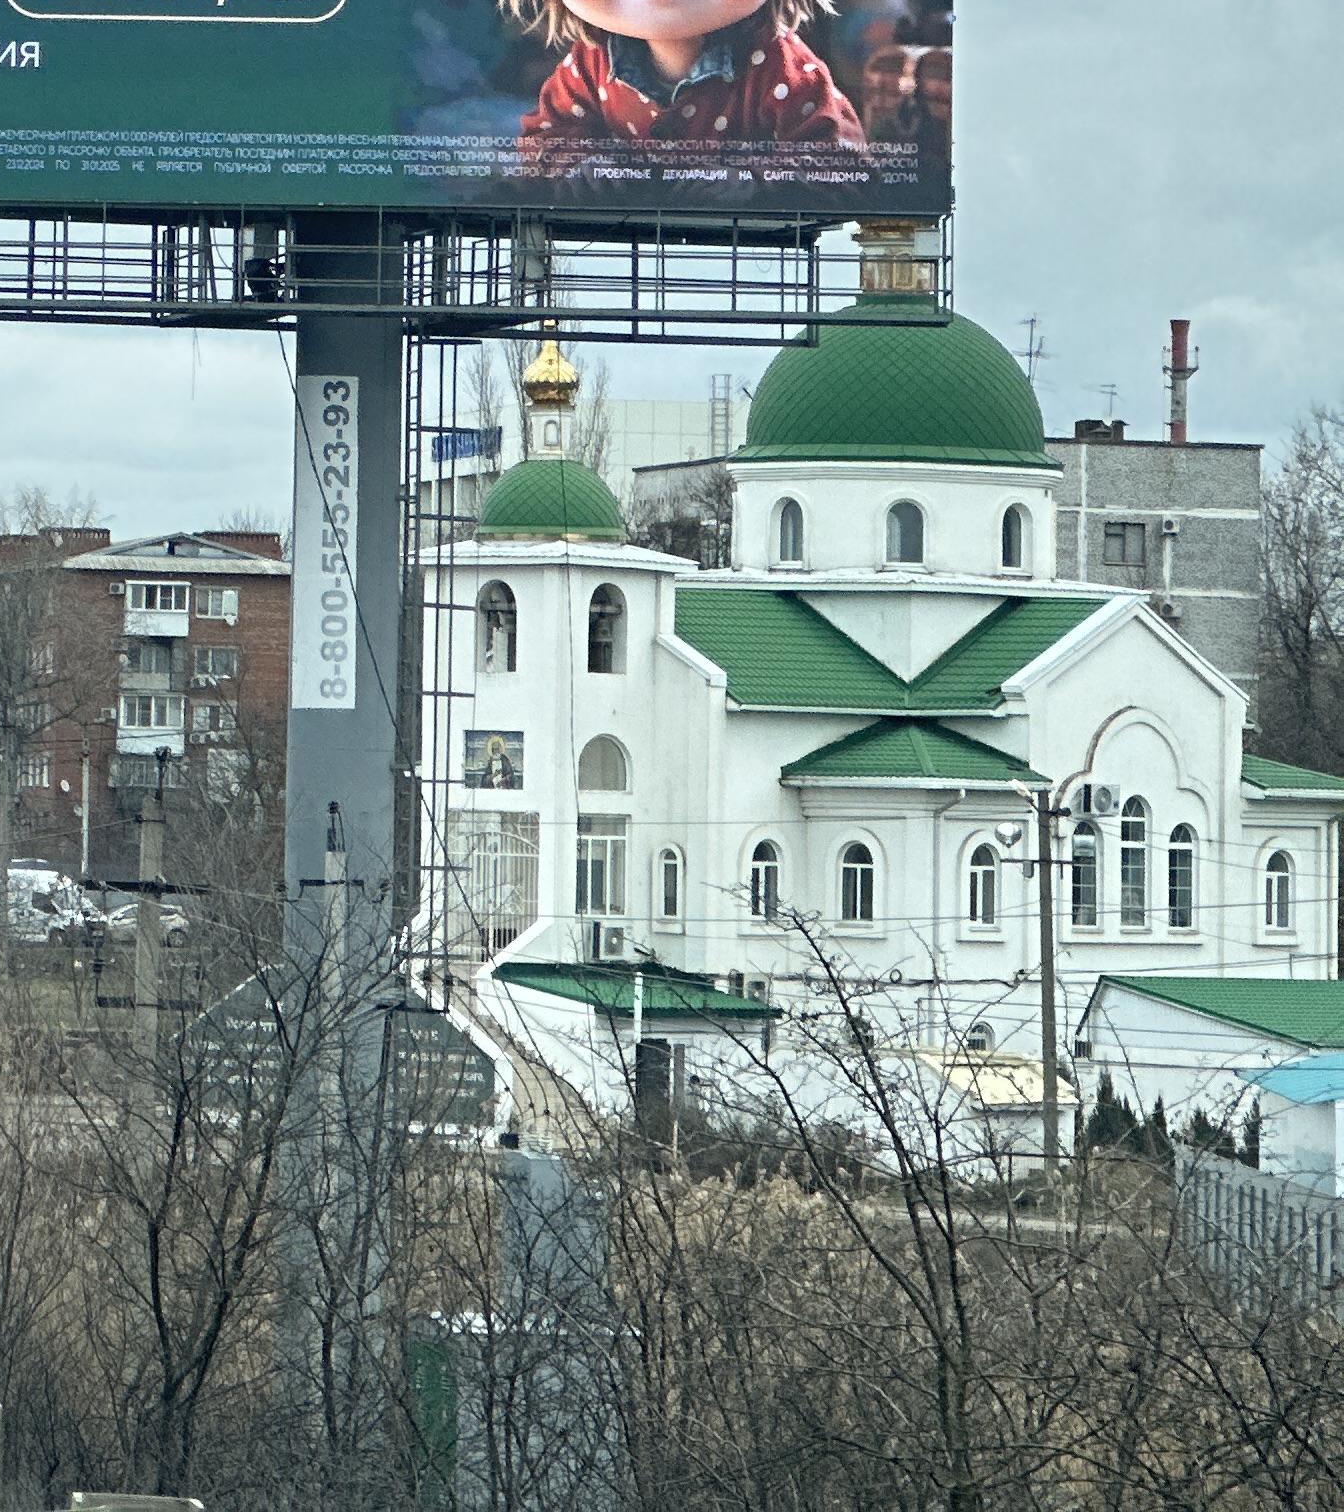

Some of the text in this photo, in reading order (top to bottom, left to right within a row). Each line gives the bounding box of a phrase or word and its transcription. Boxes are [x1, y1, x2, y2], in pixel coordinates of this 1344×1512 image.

[67, 130, 119, 141] ПЛАТЕЖОМ
[149, 130, 183, 142] РУБЛЕЙ
[184, 132, 272, 144] ПРЕДОСТАВЛЯЕТСЯ
[338, 134, 386, 145] ВНЕСЕНИЯ
[387, 134, 479, 147] ПЕРВОНАЧАЛЬНОГО
[479, 136, 516, 147] ВЗНОСА
[48, 144, 55, 155] В
[57, 145, 112, 156] РАССРОЧКУ
[158, 146, 232, 158] ПРИОБРЕТАТЕЛЬ
[235, 147, 294, 160] ПОСЛЕДНИМ
[298, 148, 350, 159] ПЛАТЕЖОМ
[352, 149, 389, 159] ОБЯЗАН
[392, 149, 451, 161] ОБЕСПЕЧИТЬ
[454, 150, 495, 162] ПОЛНУЮ
[55, 159, 71, 170] ПО
[132, 160, 145, 171] НЕ
[156, 161, 203, 172] ЯВЛЯЕТСЯ
[214, 160, 271, 173] ПУБЛИЧНОЙ
[338, 164, 393, 174] РАССРОЧКА
[404, 164, 491, 176] ПРЕДОСТАВЛЯЕТСЯ
[593, 168, 651, 179] ПРОЕКТНЫЕ
[662, 169, 728, 181] ДЕКЛАРАЦИИ
[738, 170, 752, 181] НА
[763, 168, 795, 181] САЙТЕ
[319, 380, 351, 699] 8-800-555-23-93
